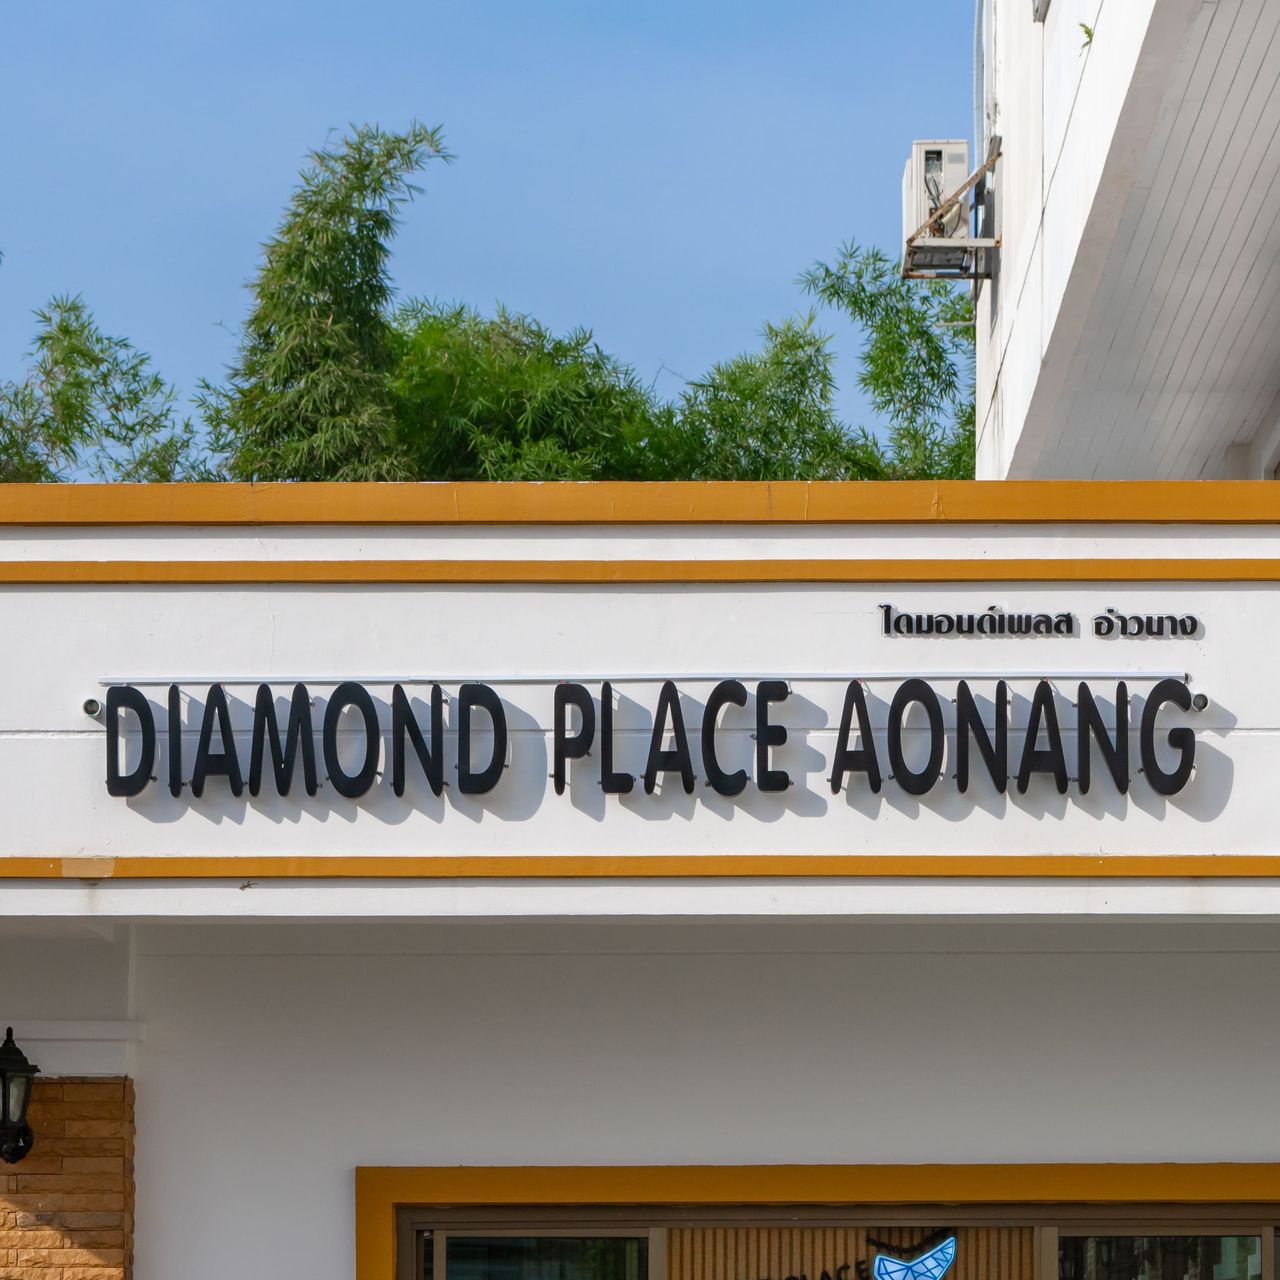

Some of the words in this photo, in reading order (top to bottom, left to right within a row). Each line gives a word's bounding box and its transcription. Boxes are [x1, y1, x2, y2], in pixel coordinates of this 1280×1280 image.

[878, 603, 1074, 636] ไดมอนด์เพลส
[1093, 607, 1199, 637] อ่าวนาง
[105, 681, 510, 799] DIAMOND
[551, 679, 794, 797] PLACE
[829, 678, 1197, 797] AONANG
